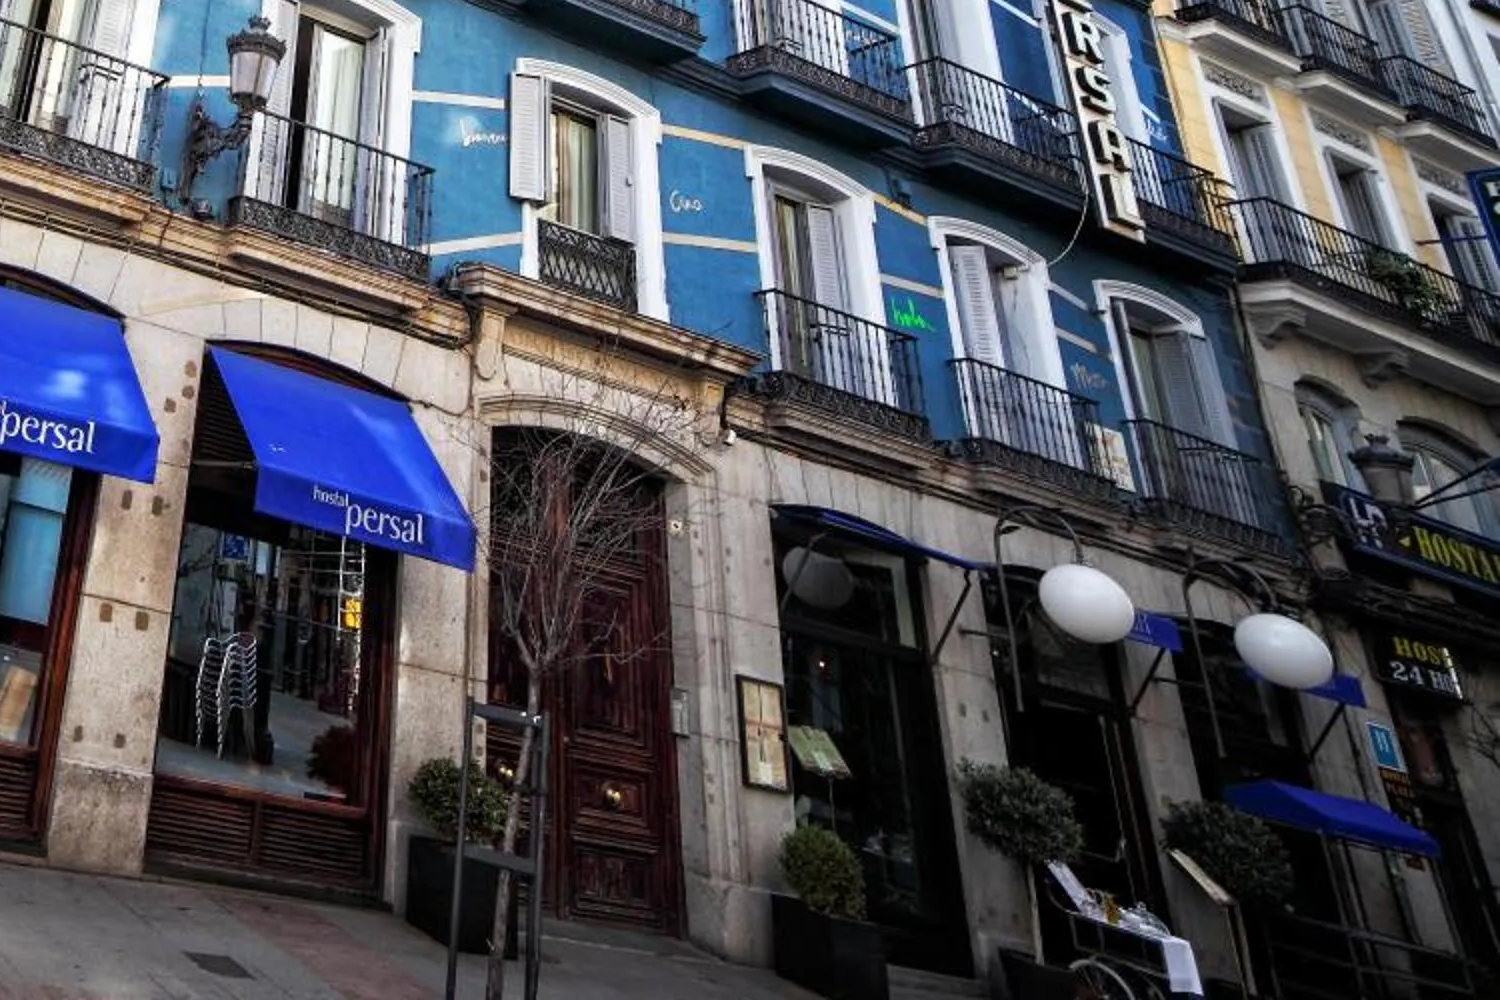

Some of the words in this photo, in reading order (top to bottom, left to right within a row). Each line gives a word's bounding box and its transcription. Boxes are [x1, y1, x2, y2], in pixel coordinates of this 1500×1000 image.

[0, 411, 96, 454] persal
[313, 484, 350, 507] hostal
[345, 503, 424, 544] persal
[1392, 635, 1451, 670] HOS
[1389, 659, 1424, 686] 24
